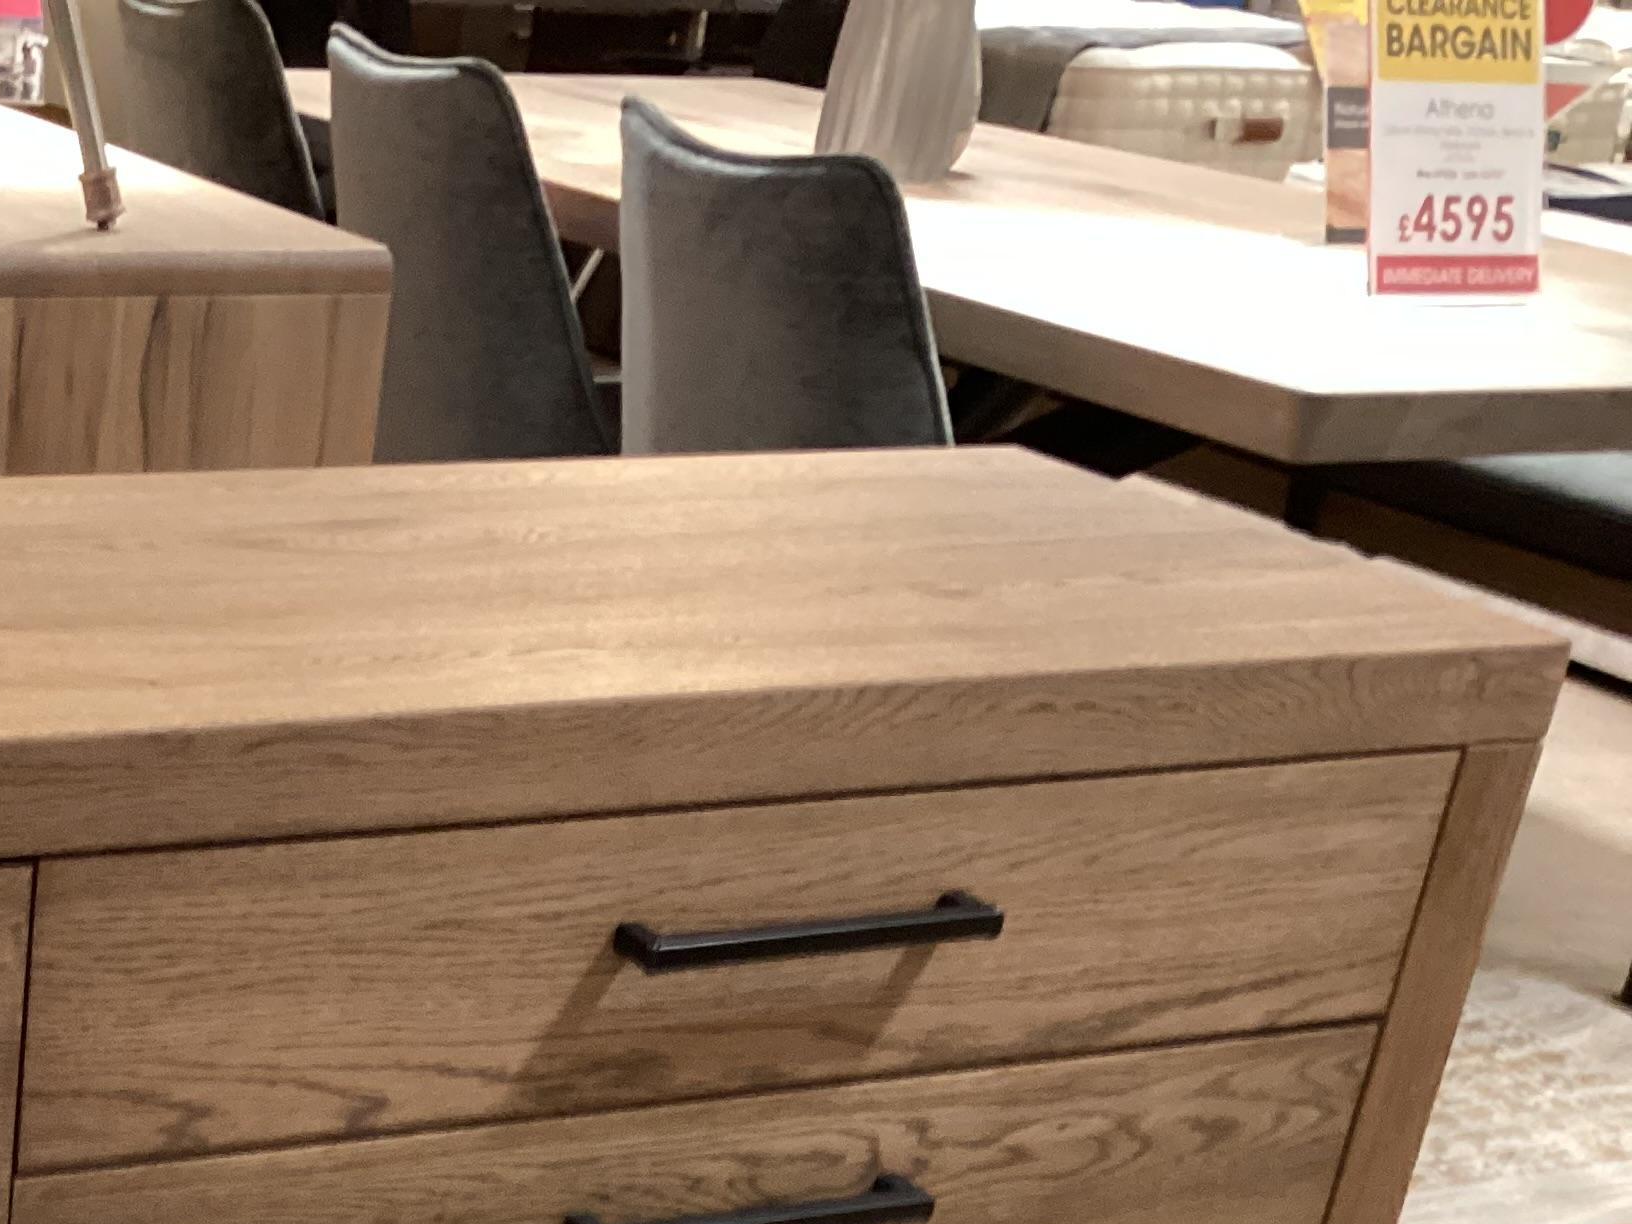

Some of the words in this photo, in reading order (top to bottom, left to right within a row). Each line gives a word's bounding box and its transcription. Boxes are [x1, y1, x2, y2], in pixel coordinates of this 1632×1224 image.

[1386, 0, 1531, 20] CLEARANCE
[1386, 22, 1532, 61] BARGAIN
[1398, 193, 1515, 242] £4595
[1382, 266, 1463, 285] IMMEDIATE
[1468, 266, 1535, 285] DELIVERY
